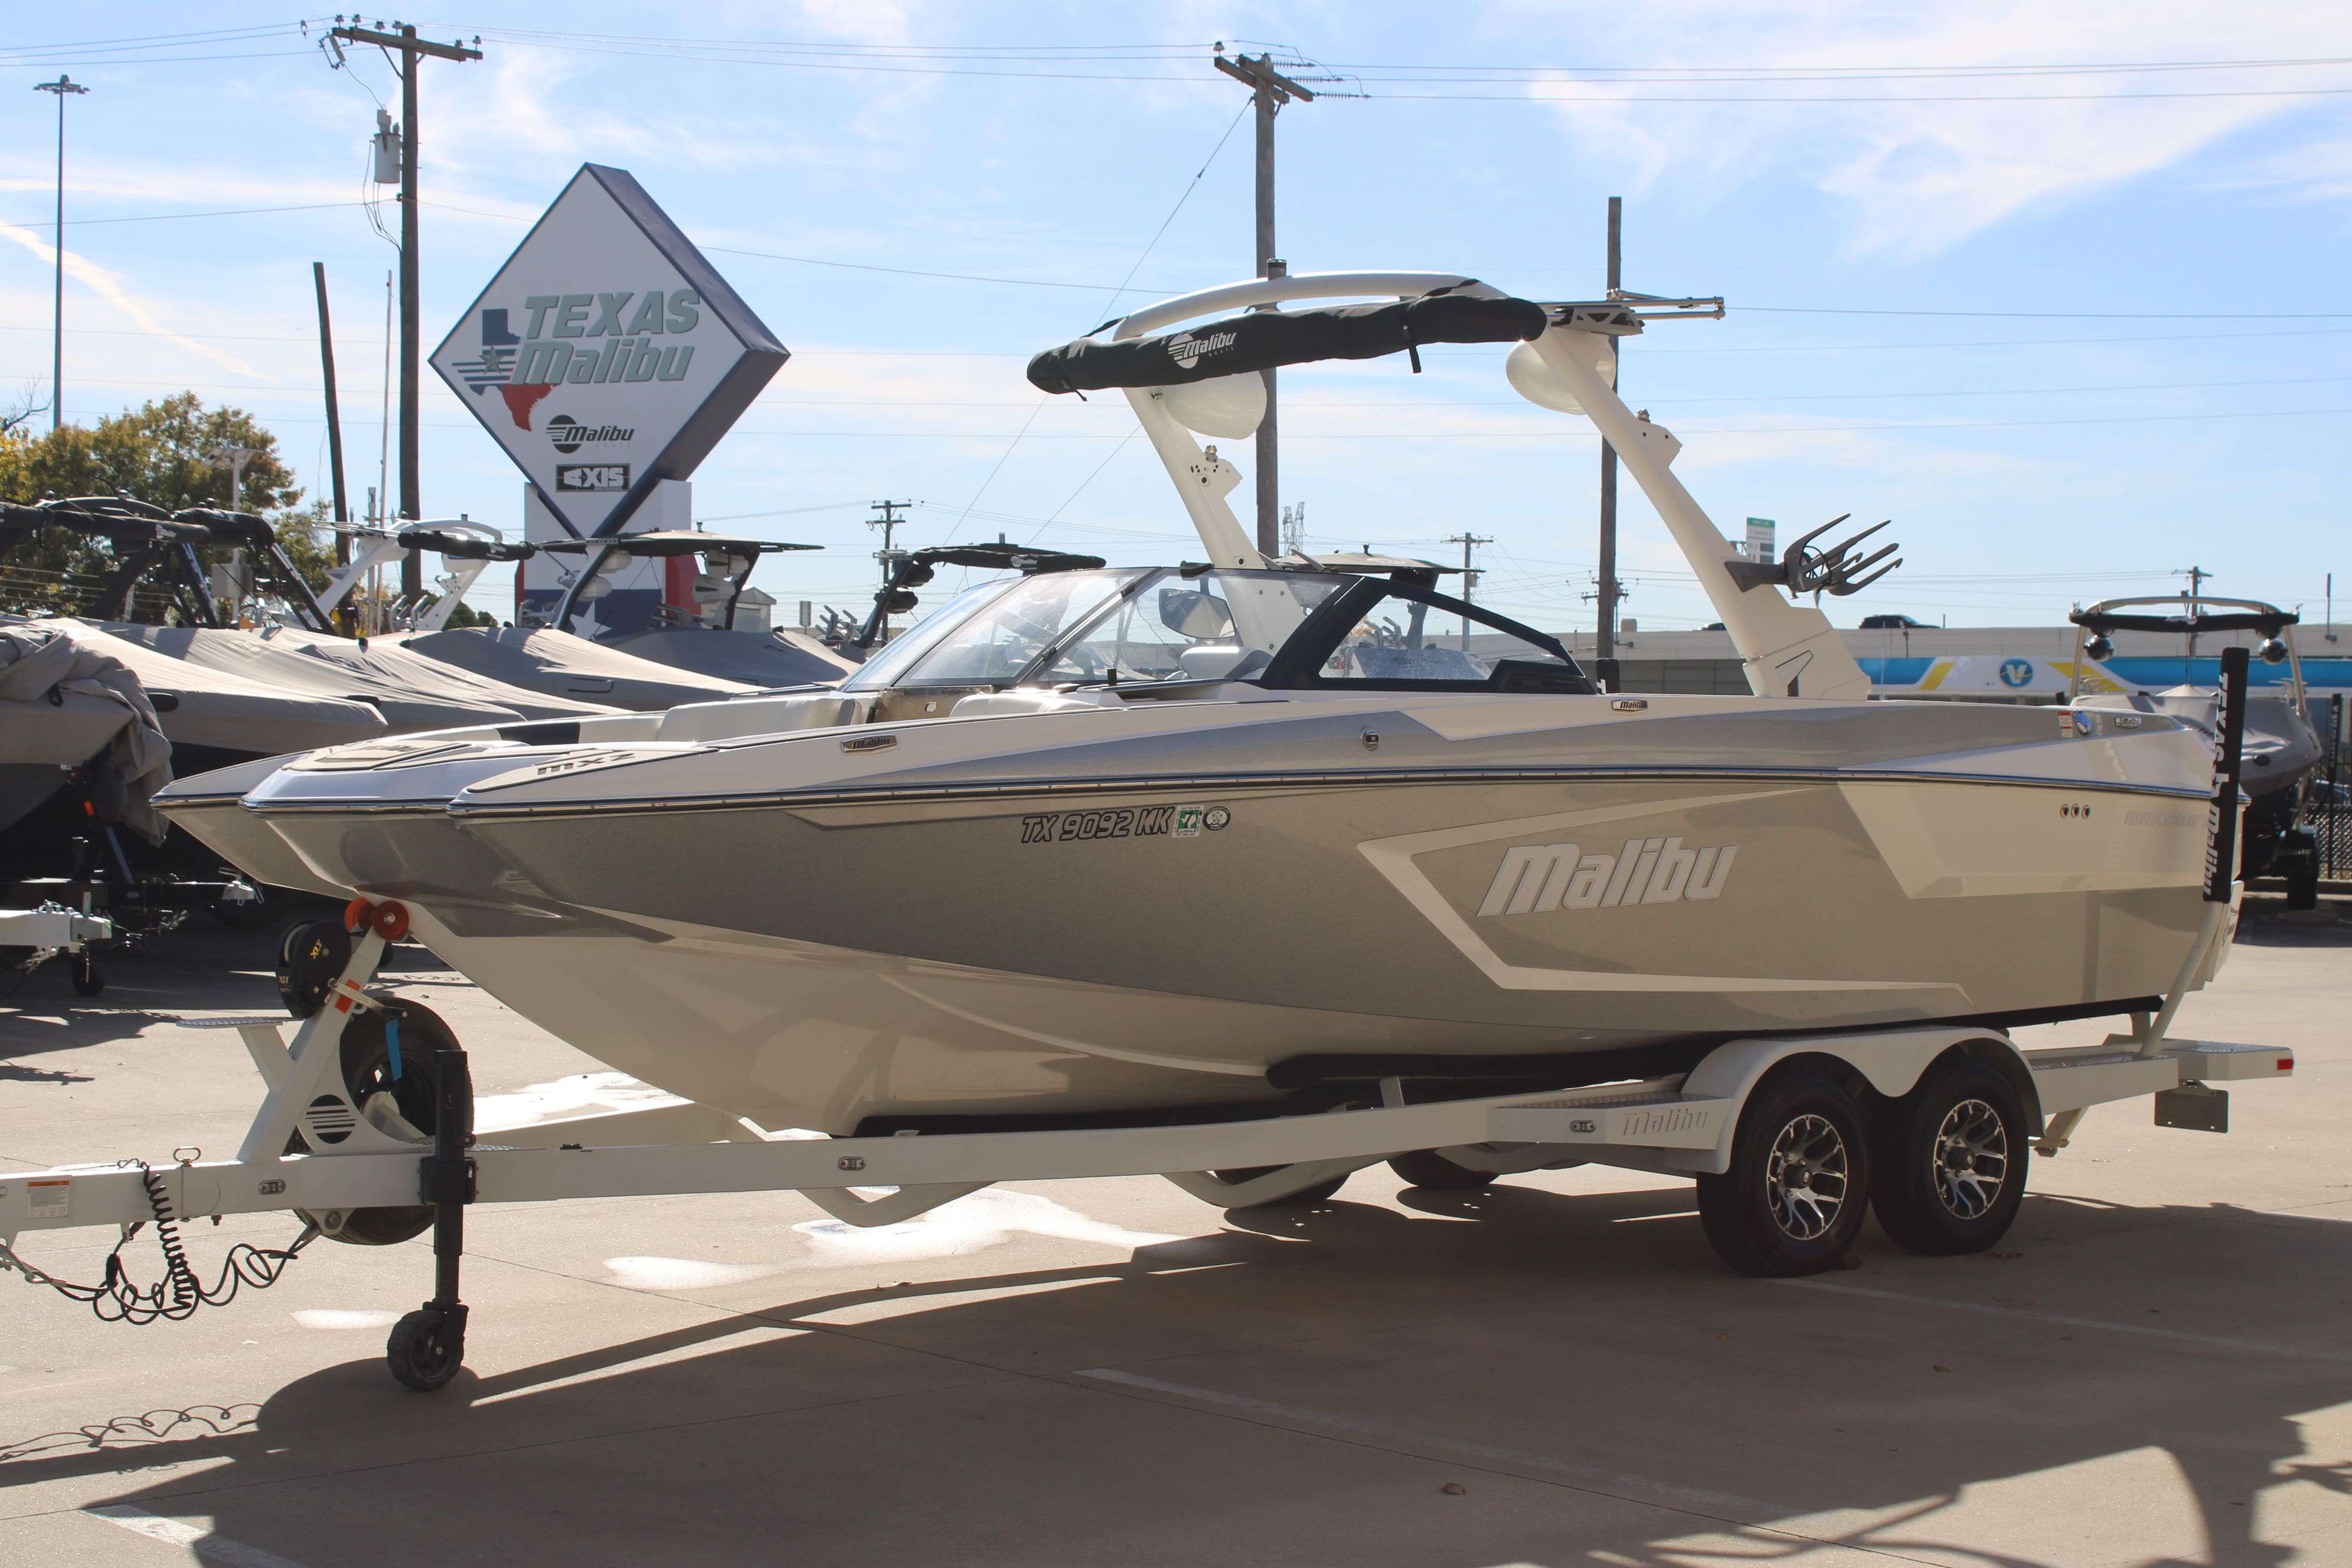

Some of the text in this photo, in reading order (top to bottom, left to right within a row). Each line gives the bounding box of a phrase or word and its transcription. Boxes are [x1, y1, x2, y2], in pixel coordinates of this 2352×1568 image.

[524, 289, 701, 339] TEXAS
[1183, 332, 1237, 358] Malibu
[510, 337, 695, 385] Malibu
[563, 426, 635, 442] Malibu
[563, 467, 625, 488] AXIS
[1619, 701, 1644, 709] Malibu
[851, 736, 890, 749] Malibu
[1021, 806, 1175, 843] TX 9092 KK
[1476, 837, 1739, 917] Malibu
[1621, 1108, 1709, 1136] Malibu
